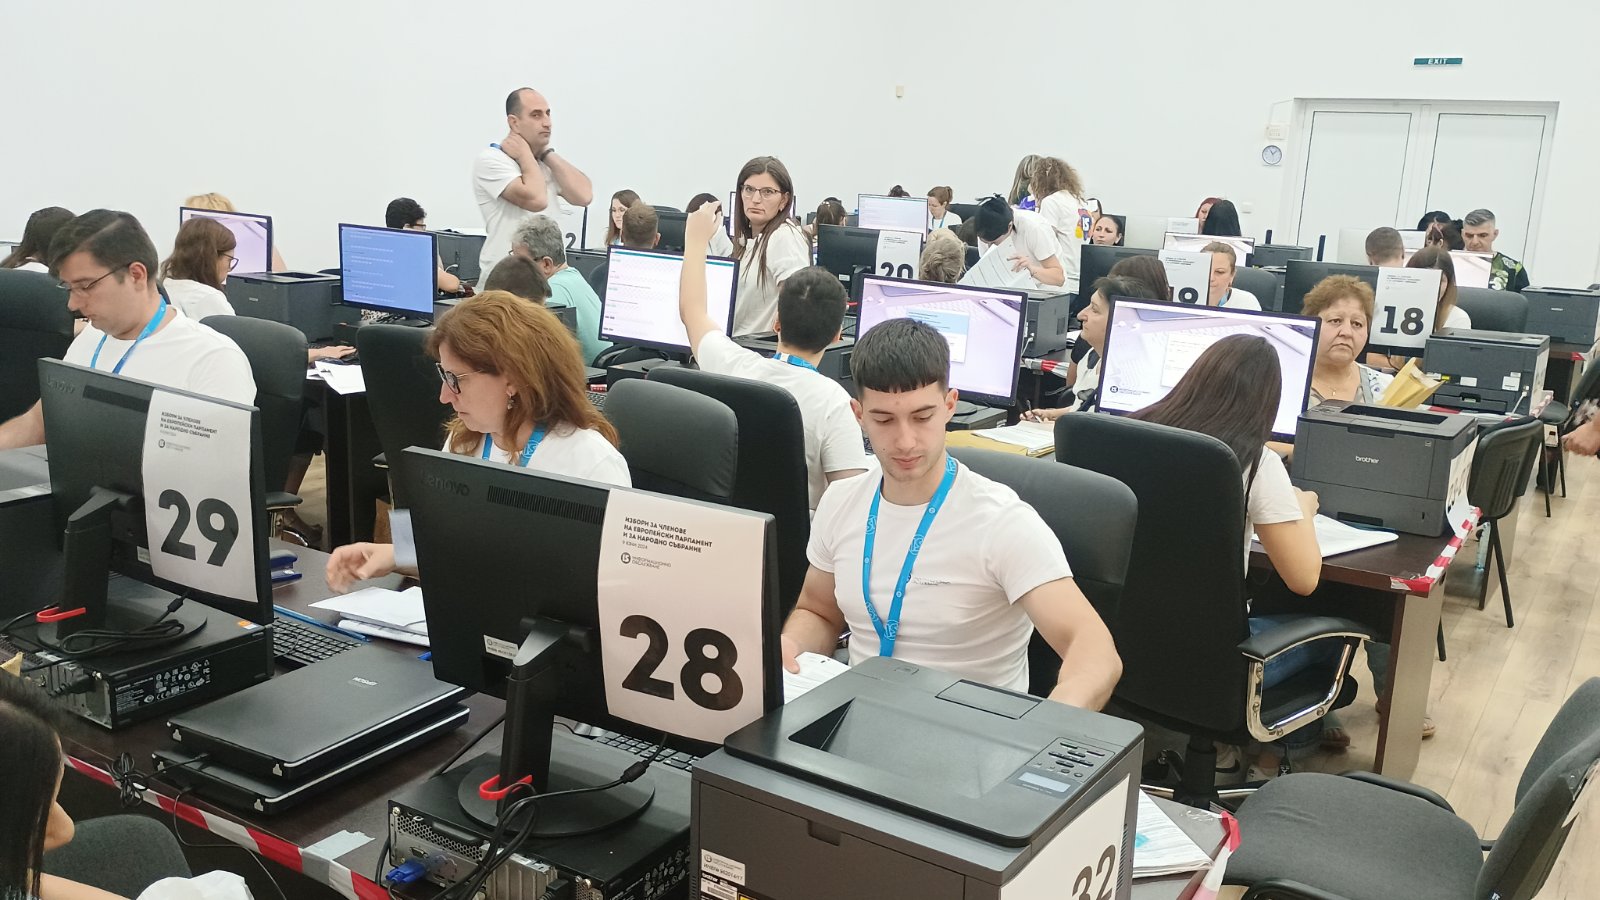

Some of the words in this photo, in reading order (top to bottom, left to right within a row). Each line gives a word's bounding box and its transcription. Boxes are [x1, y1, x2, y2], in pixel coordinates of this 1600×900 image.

[1380, 305, 1424, 336] 18
[1355, 455, 1379, 464] brother
[159, 489, 239, 567] 29
[625, 516, 649, 527] ИЗБОРИ
[658, 523, 687, 535] ЧЛЕНОВЕ
[633, 526, 674, 540] ЕВРОПЕЙСКИ
[674, 533, 713, 548] ПАРЛАМЕНТ
[637, 534, 667, 546] НАРОДНО
[668, 541, 702, 553] СЪБРАНИЕ
[620, 615, 743, 711] 28
[1072, 845, 1116, 900] 32
